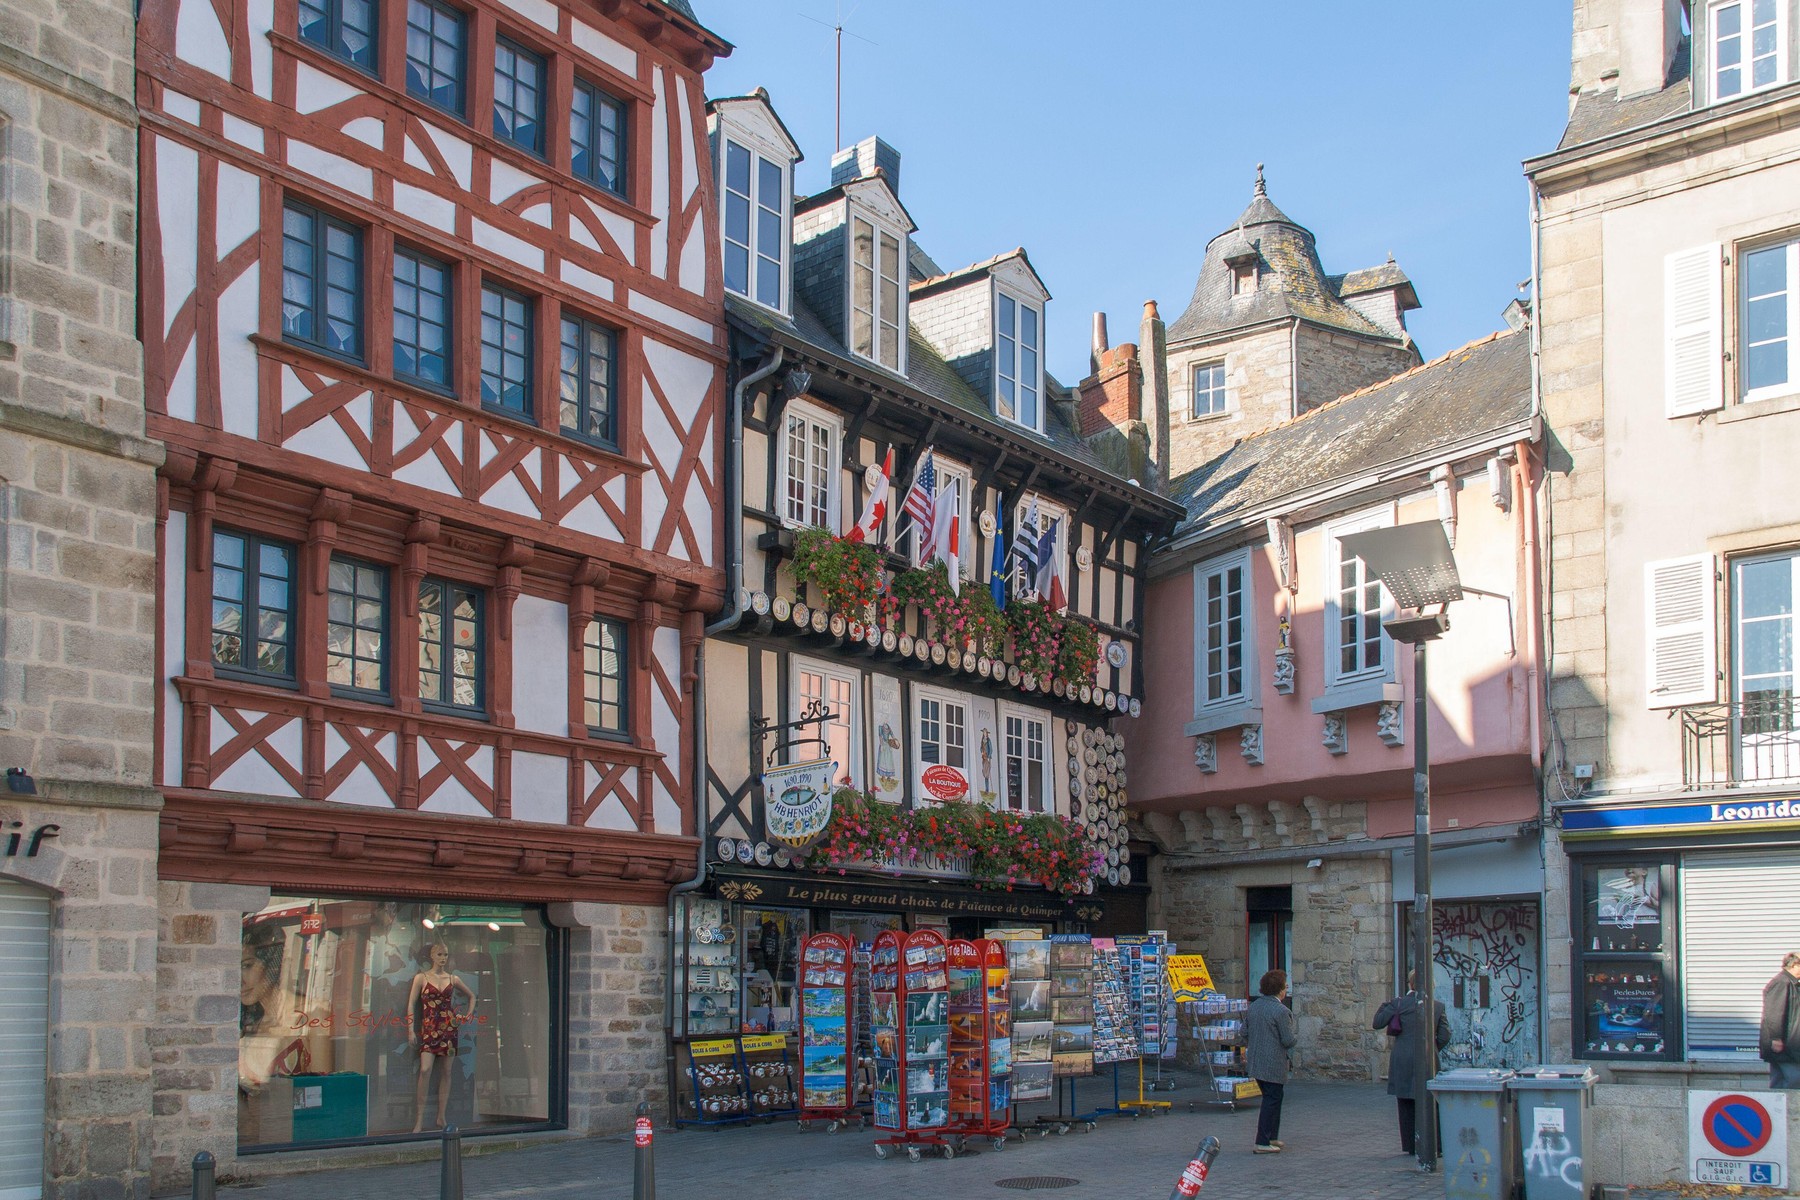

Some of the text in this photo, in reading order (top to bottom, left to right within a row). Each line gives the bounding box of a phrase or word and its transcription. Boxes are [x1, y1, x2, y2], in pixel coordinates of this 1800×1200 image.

[936, 779, 962, 788] BOUTIQUE
[774, 793, 822, 818] HB HENRIOT
[786, 886, 1064, 918] Le plus grand choix de Faïence de Quimper
[811, 939, 821, 947] Set
[825, 936, 839, 947] Table
[910, 936, 919, 945] Set
[923, 934, 937, 945] Table
[953, 944, 960, 956] de
[960, 943, 977, 956] TABLE
[290, 1009, 336, 1030] Des
[346, 1007, 414, 1036] Styles
